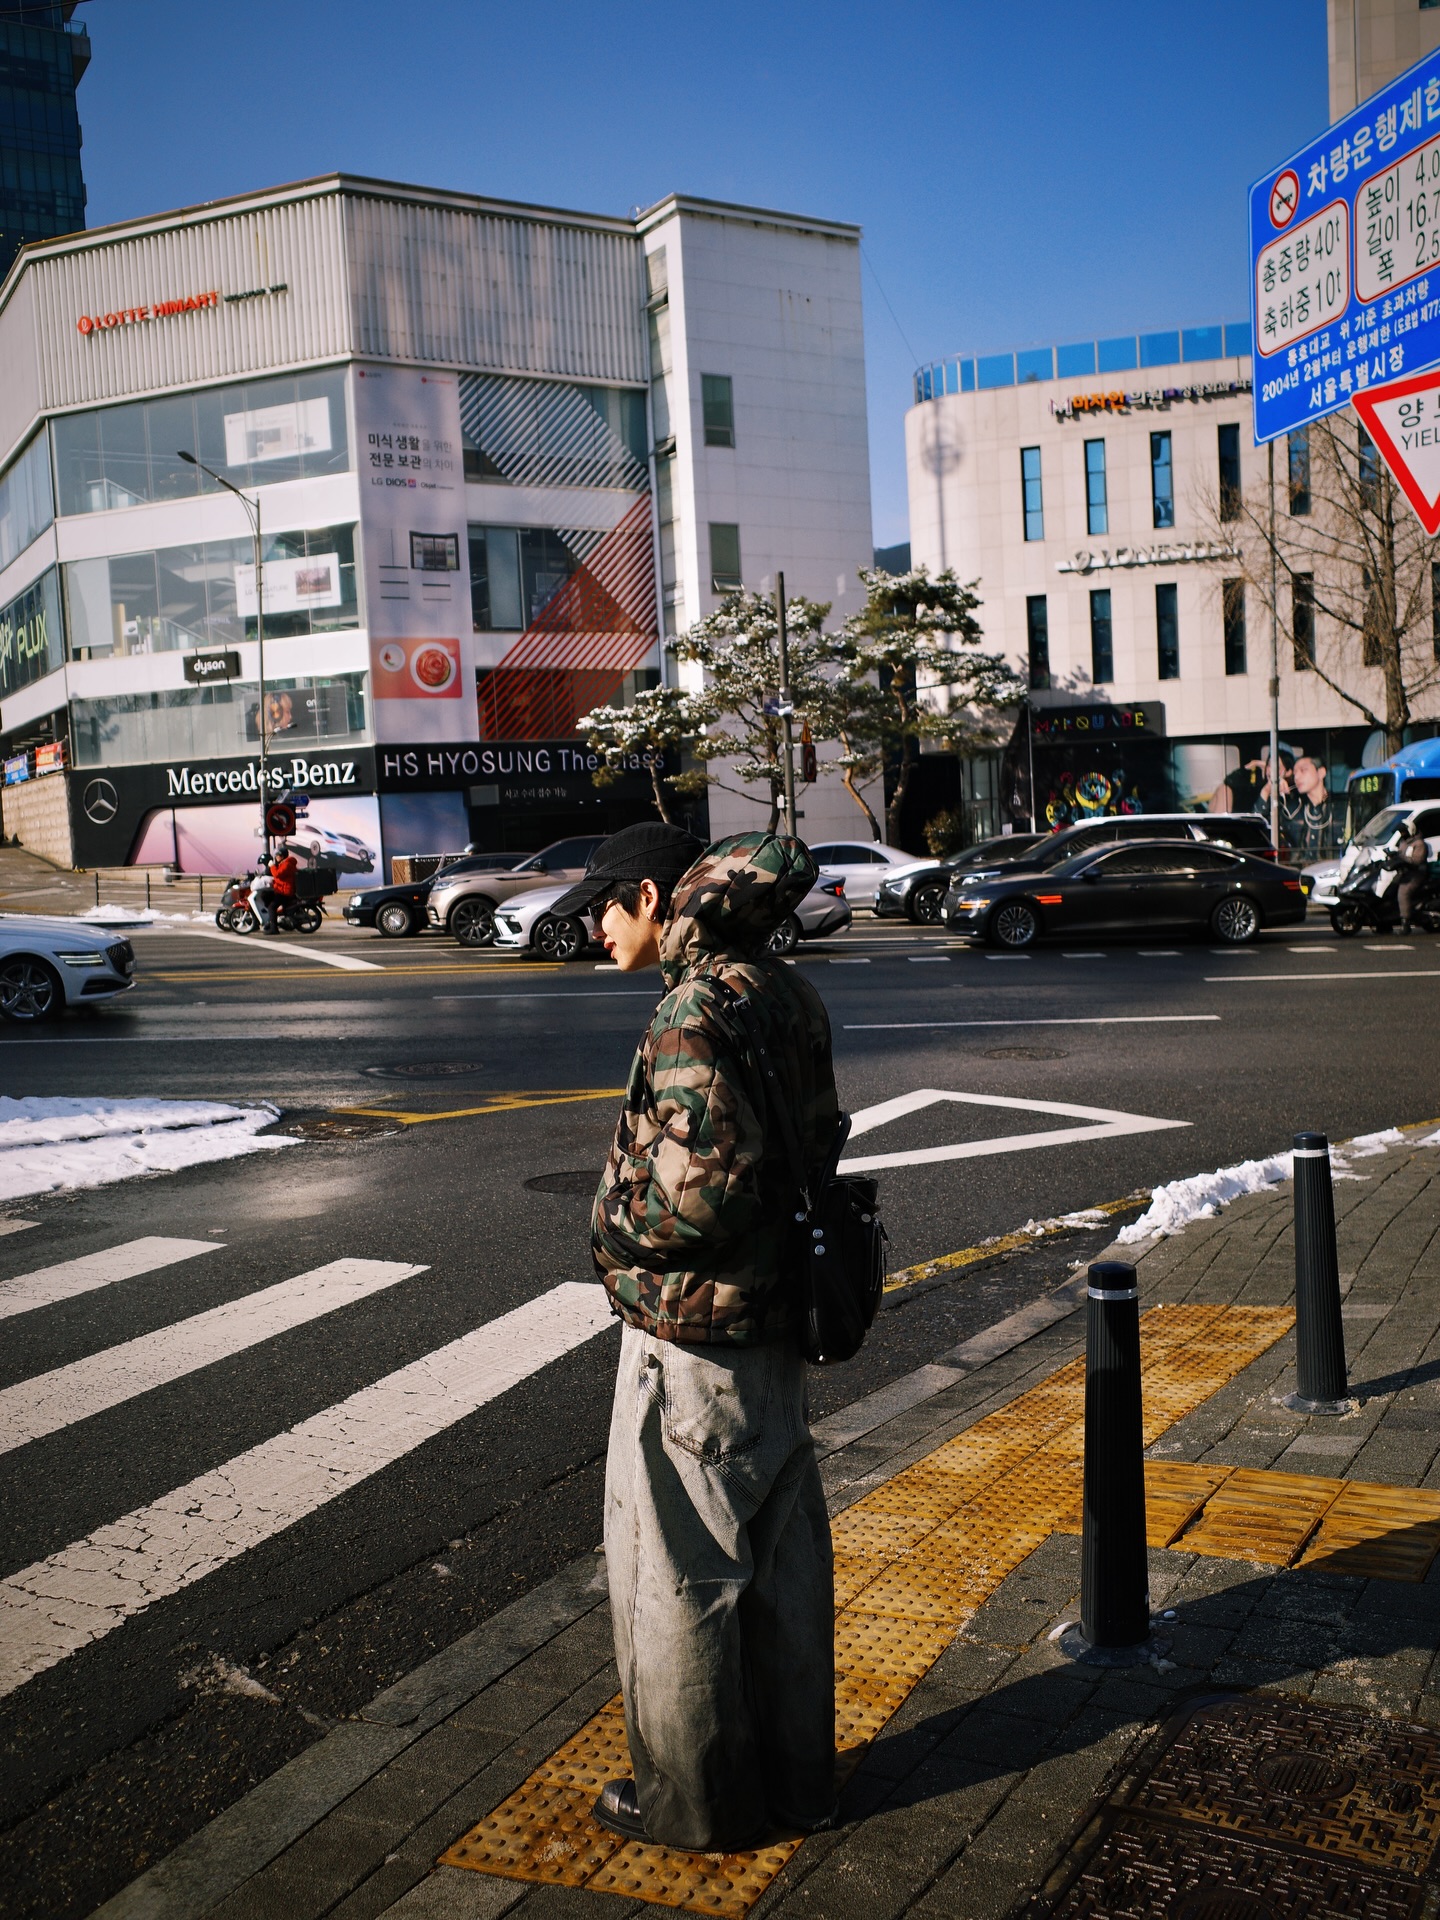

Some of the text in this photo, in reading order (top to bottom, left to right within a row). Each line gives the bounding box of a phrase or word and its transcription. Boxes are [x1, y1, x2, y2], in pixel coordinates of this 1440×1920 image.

[1366, 167, 1399, 220] 높이
[1367, 206, 1399, 256] 길이
[1377, 249, 1394, 282] 폭
[94, 306, 149, 329] LOTTE
[153, 291, 219, 318] HIMART
[1340, 320, 1350, 340] 위
[1354, 307, 1376, 332] 기준
[1382, 278, 1429, 319] 초과차량
[1262, 368, 1299, 403] 2004년
[1304, 347, 1341, 381] 2월부터
[1346, 323, 1391, 360] 운행제한
[1420, 297, 1440, 322] 제77
[1309, 343, 1405, 409] 서울특별시장
[368, 433, 392, 449] 미식
[369, 452, 394, 468] 전문
[371, 477, 383, 486] LG
[385, 477, 407, 488] DIOS
[17, 609, 48, 664] PLUX
[193, 659, 226, 675] dyson
[384, 752, 420, 777] HS
[427, 749, 550, 776] HYOSUNG
[558, 748, 598, 772] The
